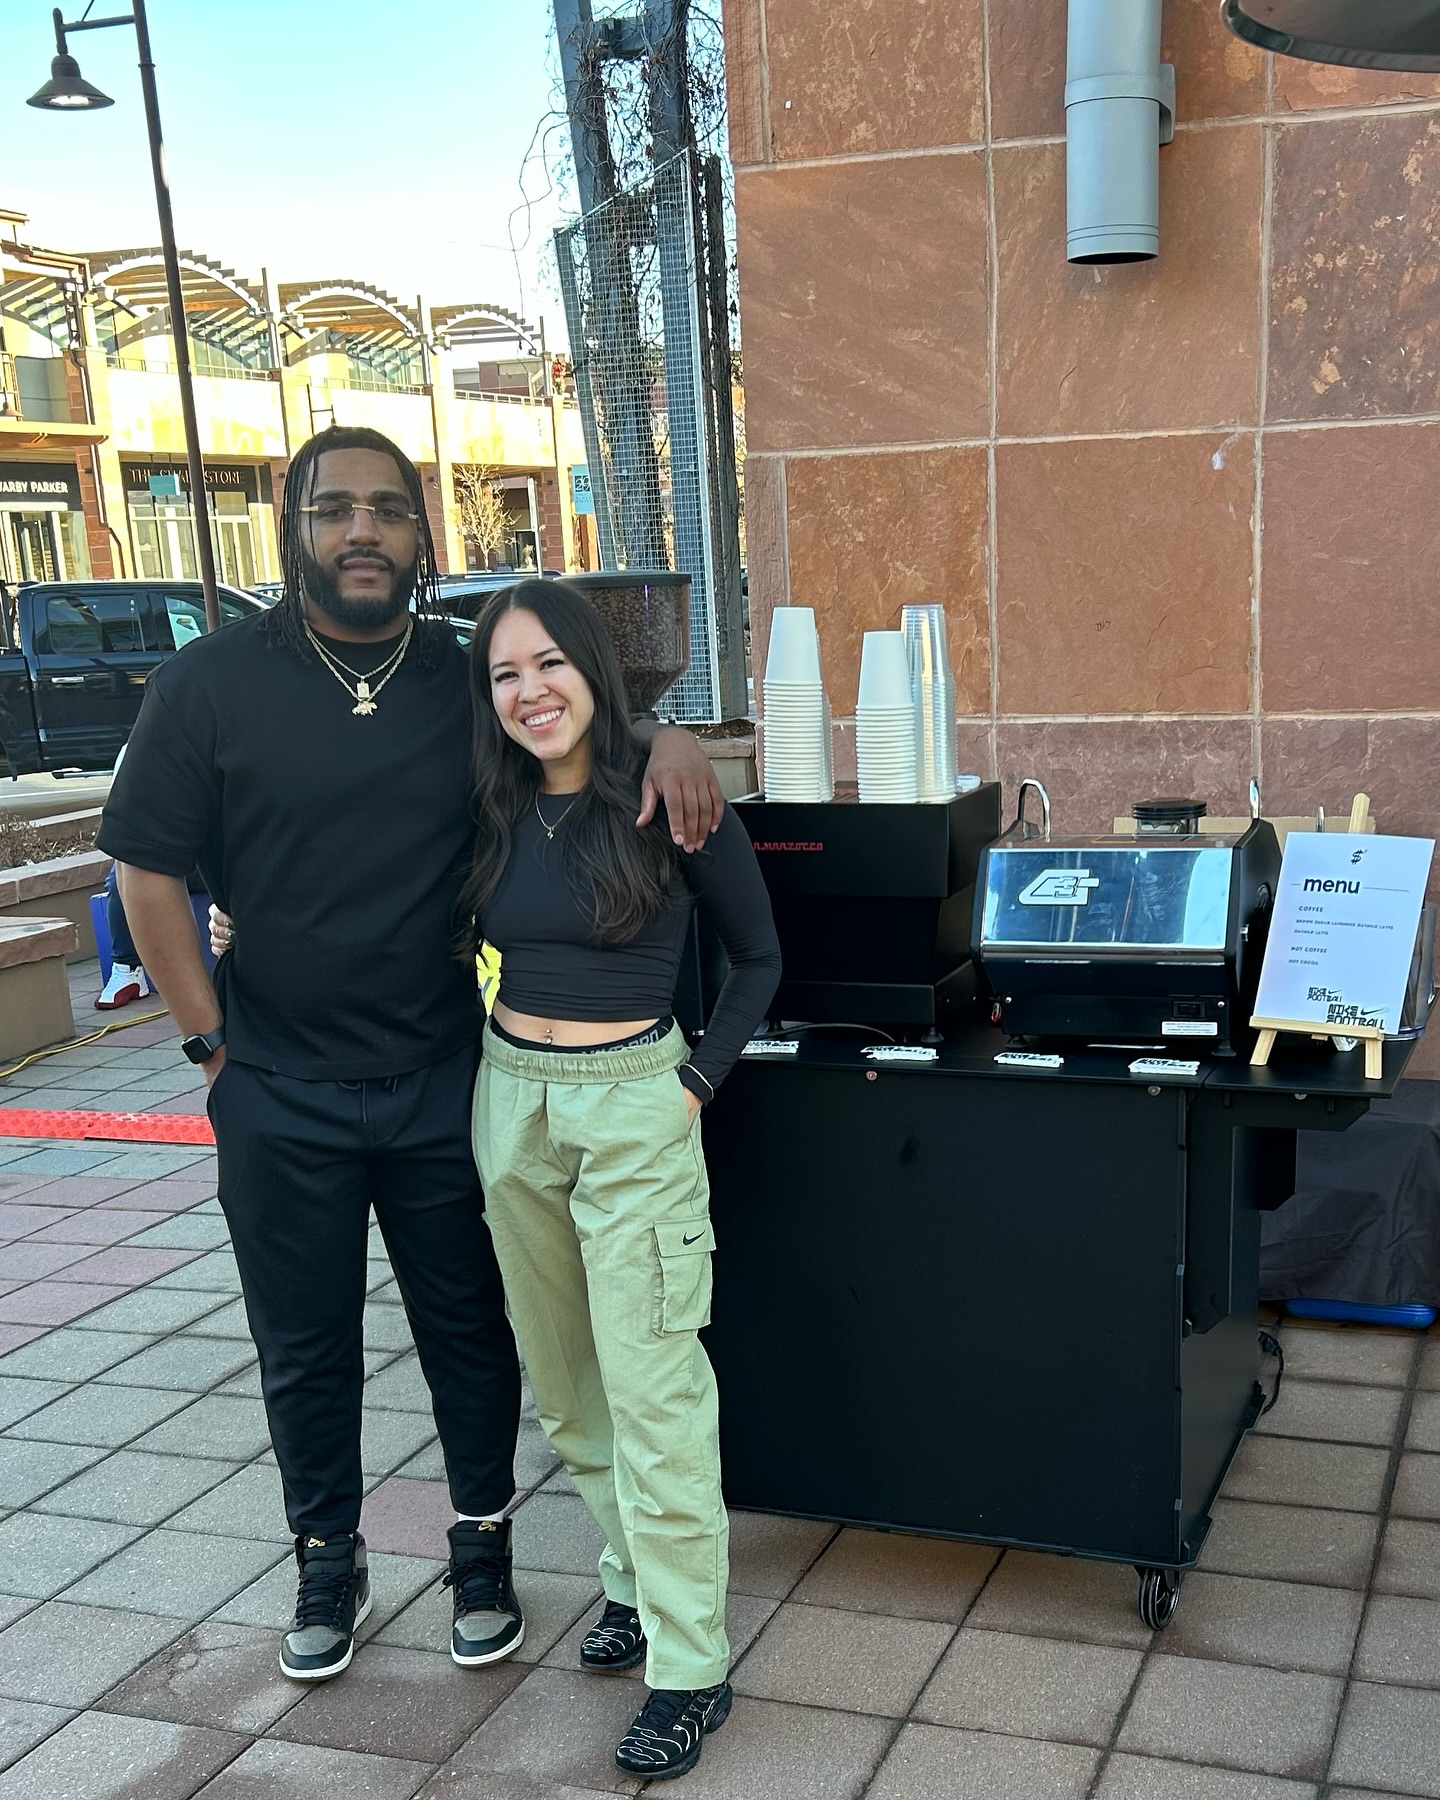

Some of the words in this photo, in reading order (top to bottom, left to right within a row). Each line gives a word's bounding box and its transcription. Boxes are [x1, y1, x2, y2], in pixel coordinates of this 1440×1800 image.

[204, 470, 244, 484] STORE
[0, 481, 28, 493] ARBY
[30, 481, 68, 494] PARKER
[1303, 879, 1360, 894] menu
[1298, 905, 1324, 913] COFFEE
[1304, 946, 1328, 954] COFFEE
[1308, 986, 1327, 996] NIKE
[1328, 1004, 1358, 1016] NIKE
